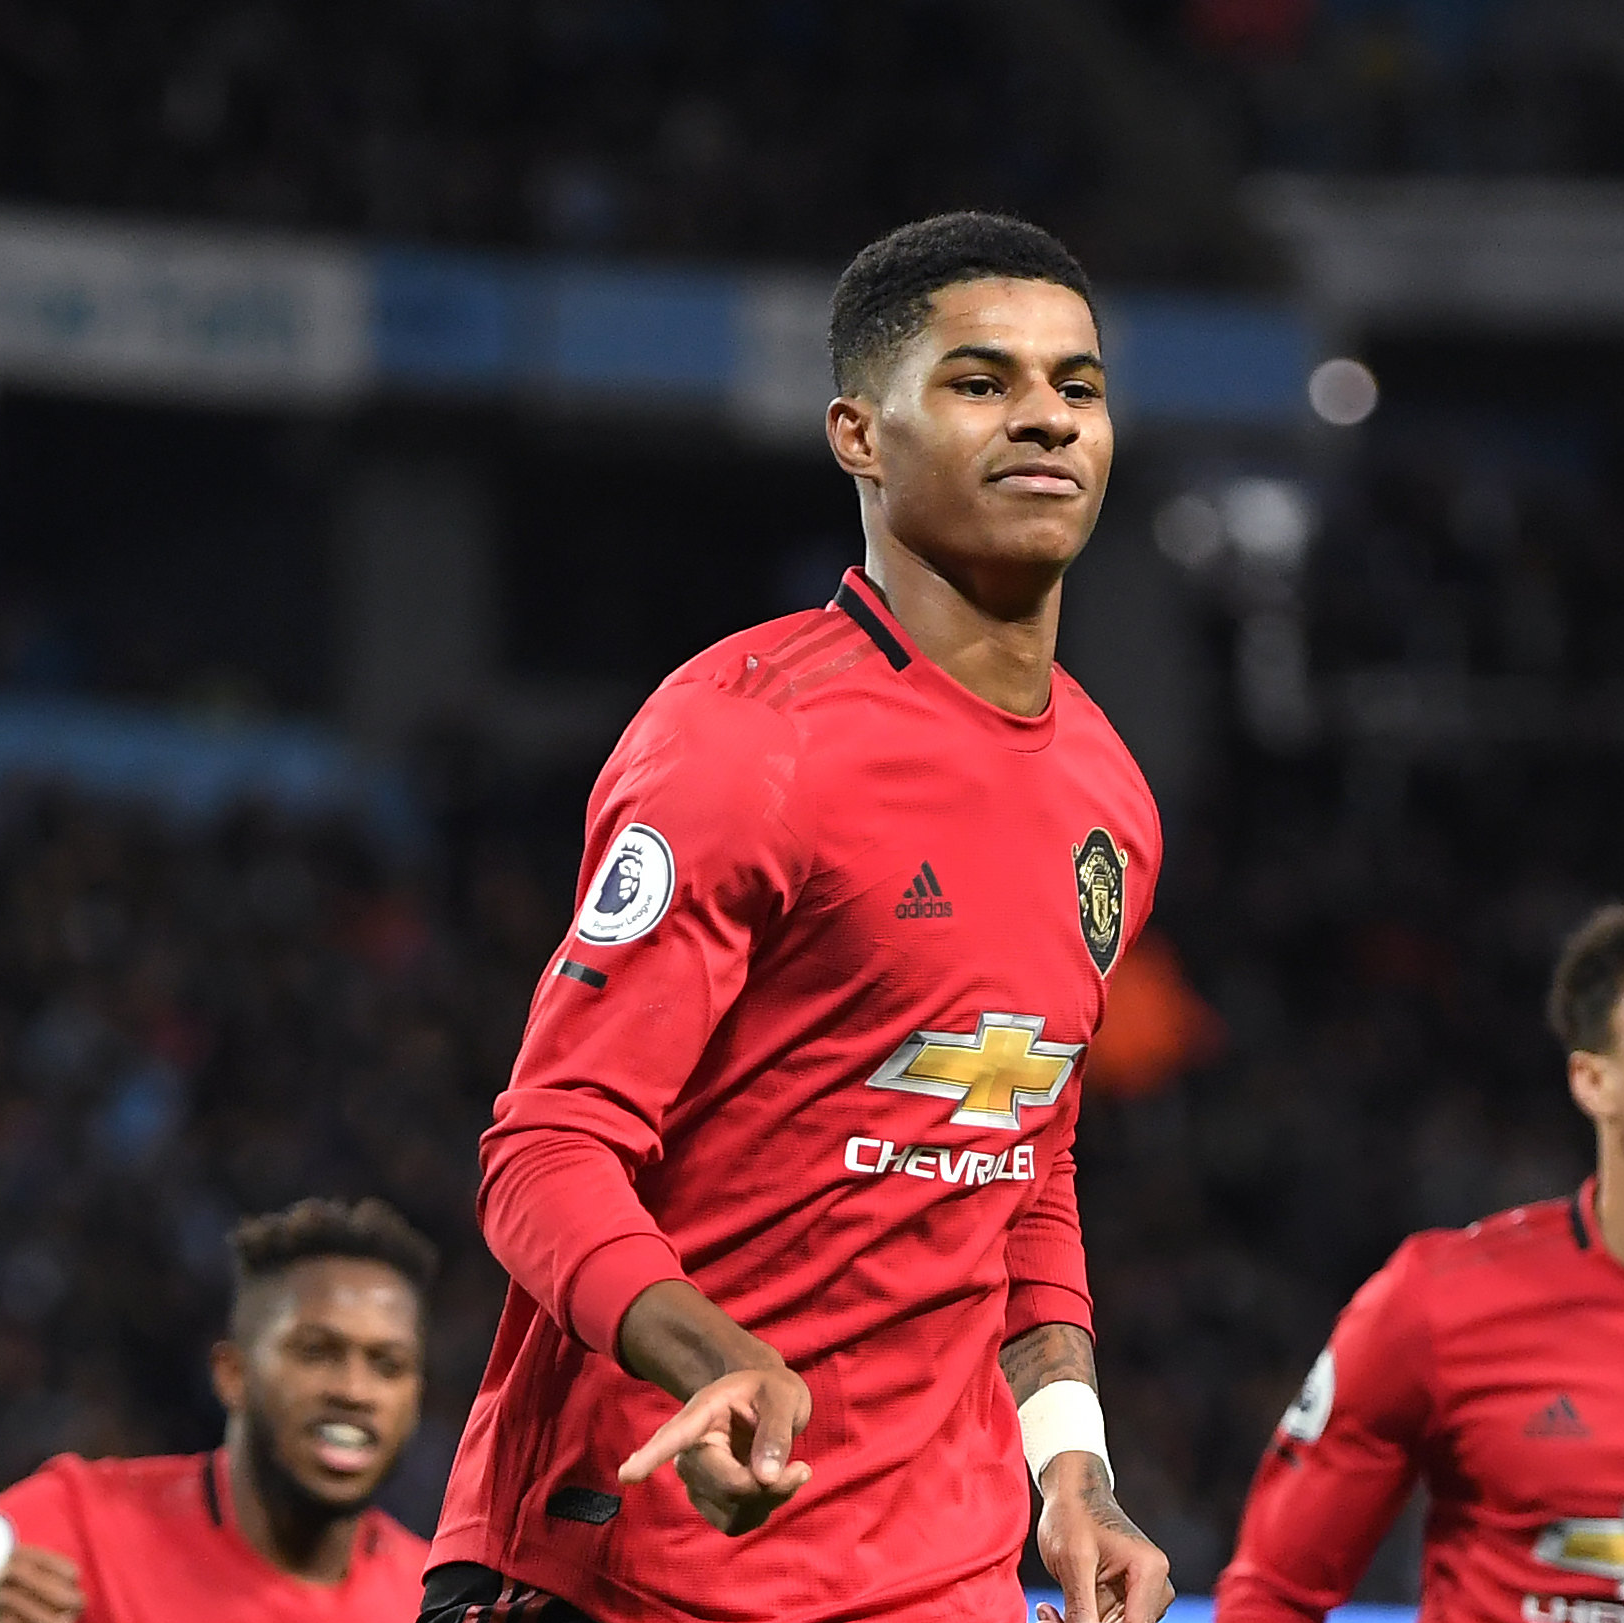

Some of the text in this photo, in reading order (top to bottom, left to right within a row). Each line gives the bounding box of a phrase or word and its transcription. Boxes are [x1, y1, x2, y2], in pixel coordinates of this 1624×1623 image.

[591, 893, 654, 932] Premier League
[895, 898, 953, 920] adidas
